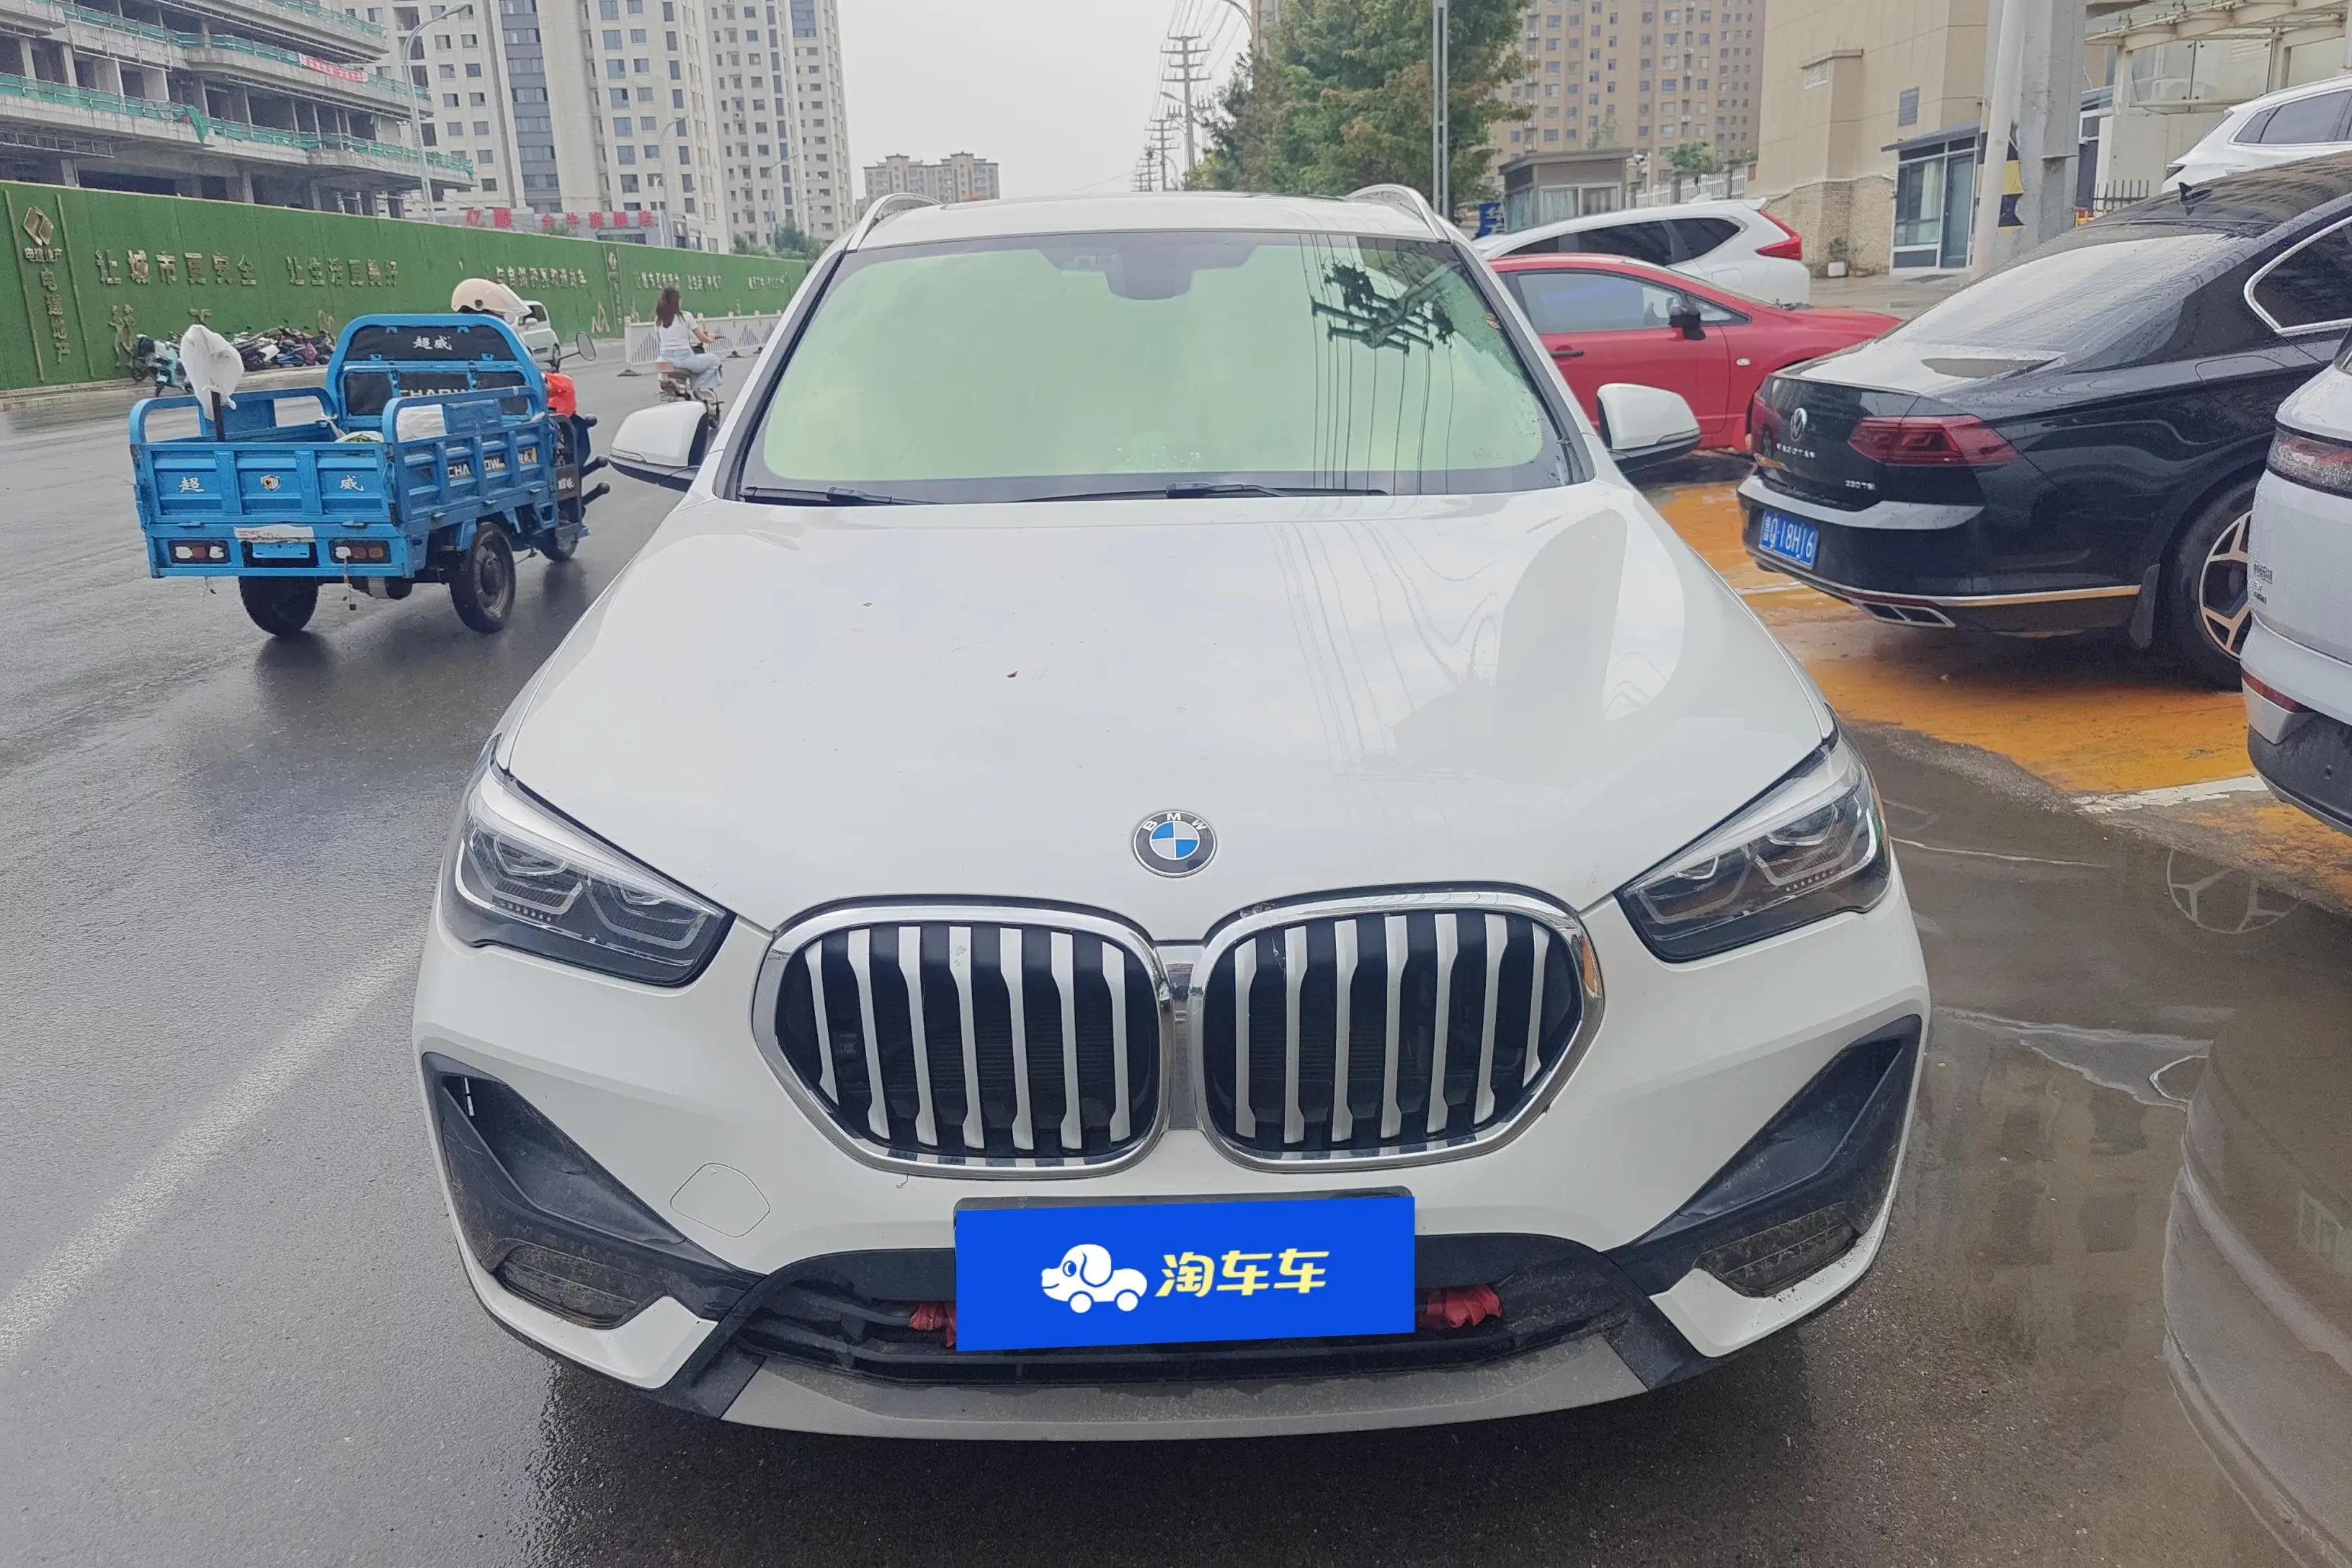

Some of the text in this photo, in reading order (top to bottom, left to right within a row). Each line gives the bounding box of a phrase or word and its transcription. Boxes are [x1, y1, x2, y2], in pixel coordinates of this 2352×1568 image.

[413, 334, 453, 351] 超威
[179, 476, 205, 494] 超
[339, 474, 365, 492] 威
[1142, 812, 1208, 832] BMW
